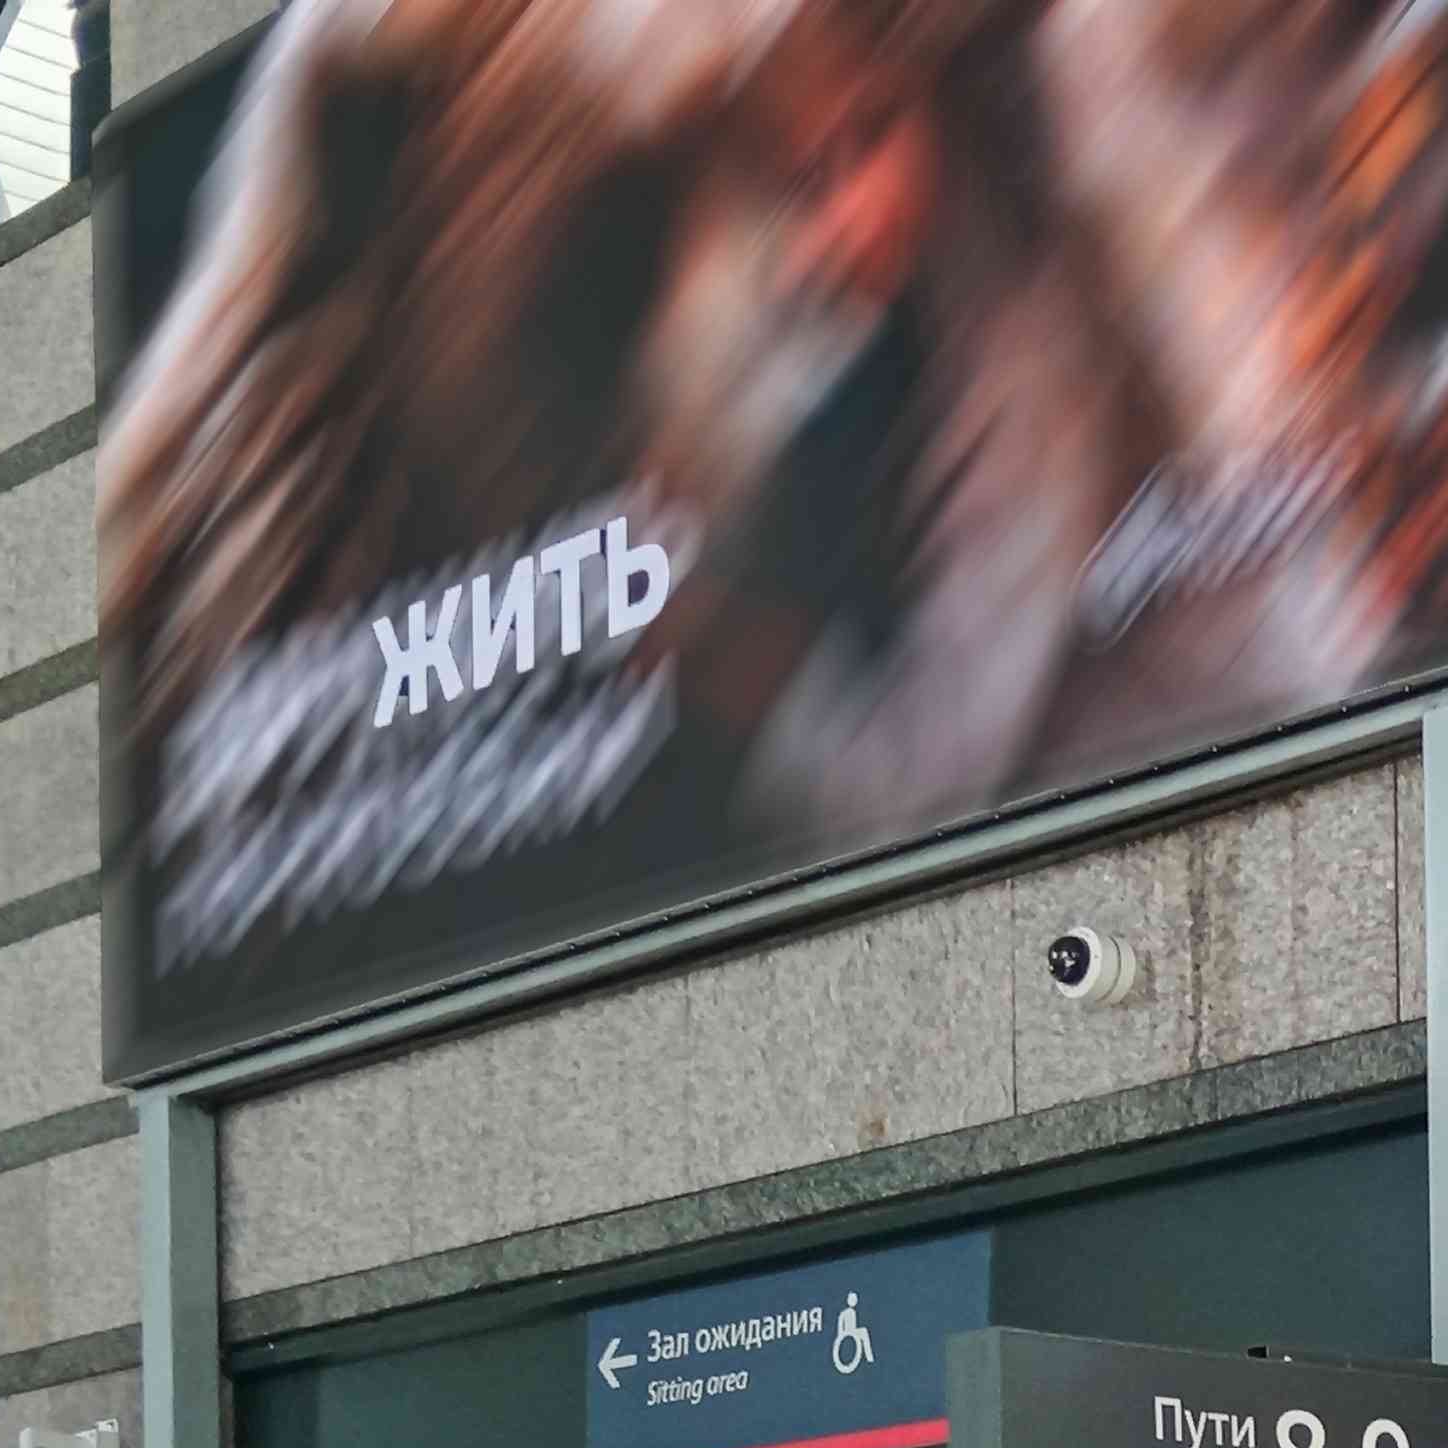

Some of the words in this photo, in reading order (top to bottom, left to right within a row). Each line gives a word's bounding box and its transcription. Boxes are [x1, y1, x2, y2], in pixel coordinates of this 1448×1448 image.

[372, 516, 671, 728] ЖИТЬ
[648, 1329, 688, 1362] Зал
[695, 1306, 823, 1354] ожидания
[648, 1376, 702, 1406] Sitting
[706, 1369, 748, 1395] area
